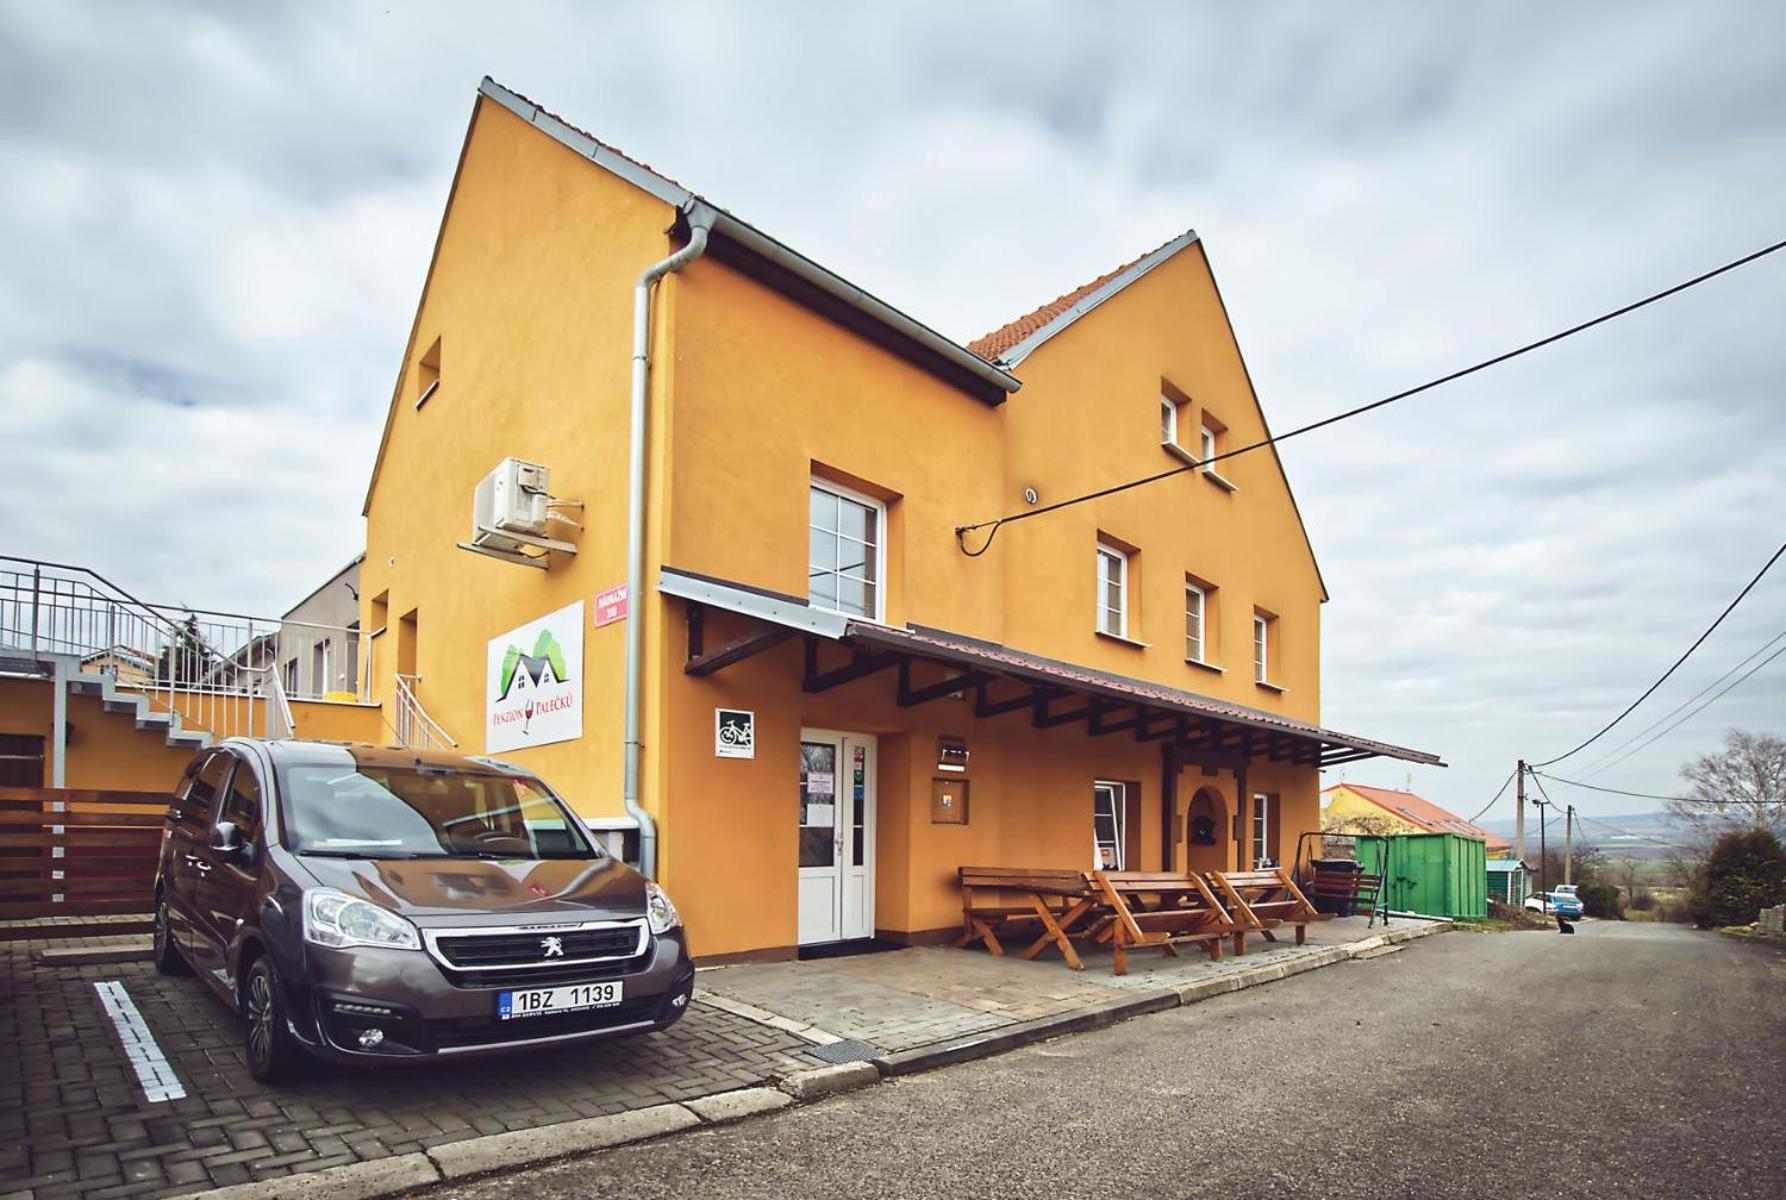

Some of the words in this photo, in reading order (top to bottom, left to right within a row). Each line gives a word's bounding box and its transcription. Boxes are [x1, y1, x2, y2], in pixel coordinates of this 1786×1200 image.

[493, 709, 523, 726] PENZION
[536, 691, 573, 715] PALEČKŮ
[518, 991, 554, 1011] 1BZ
[570, 985, 614, 1004] 1139
